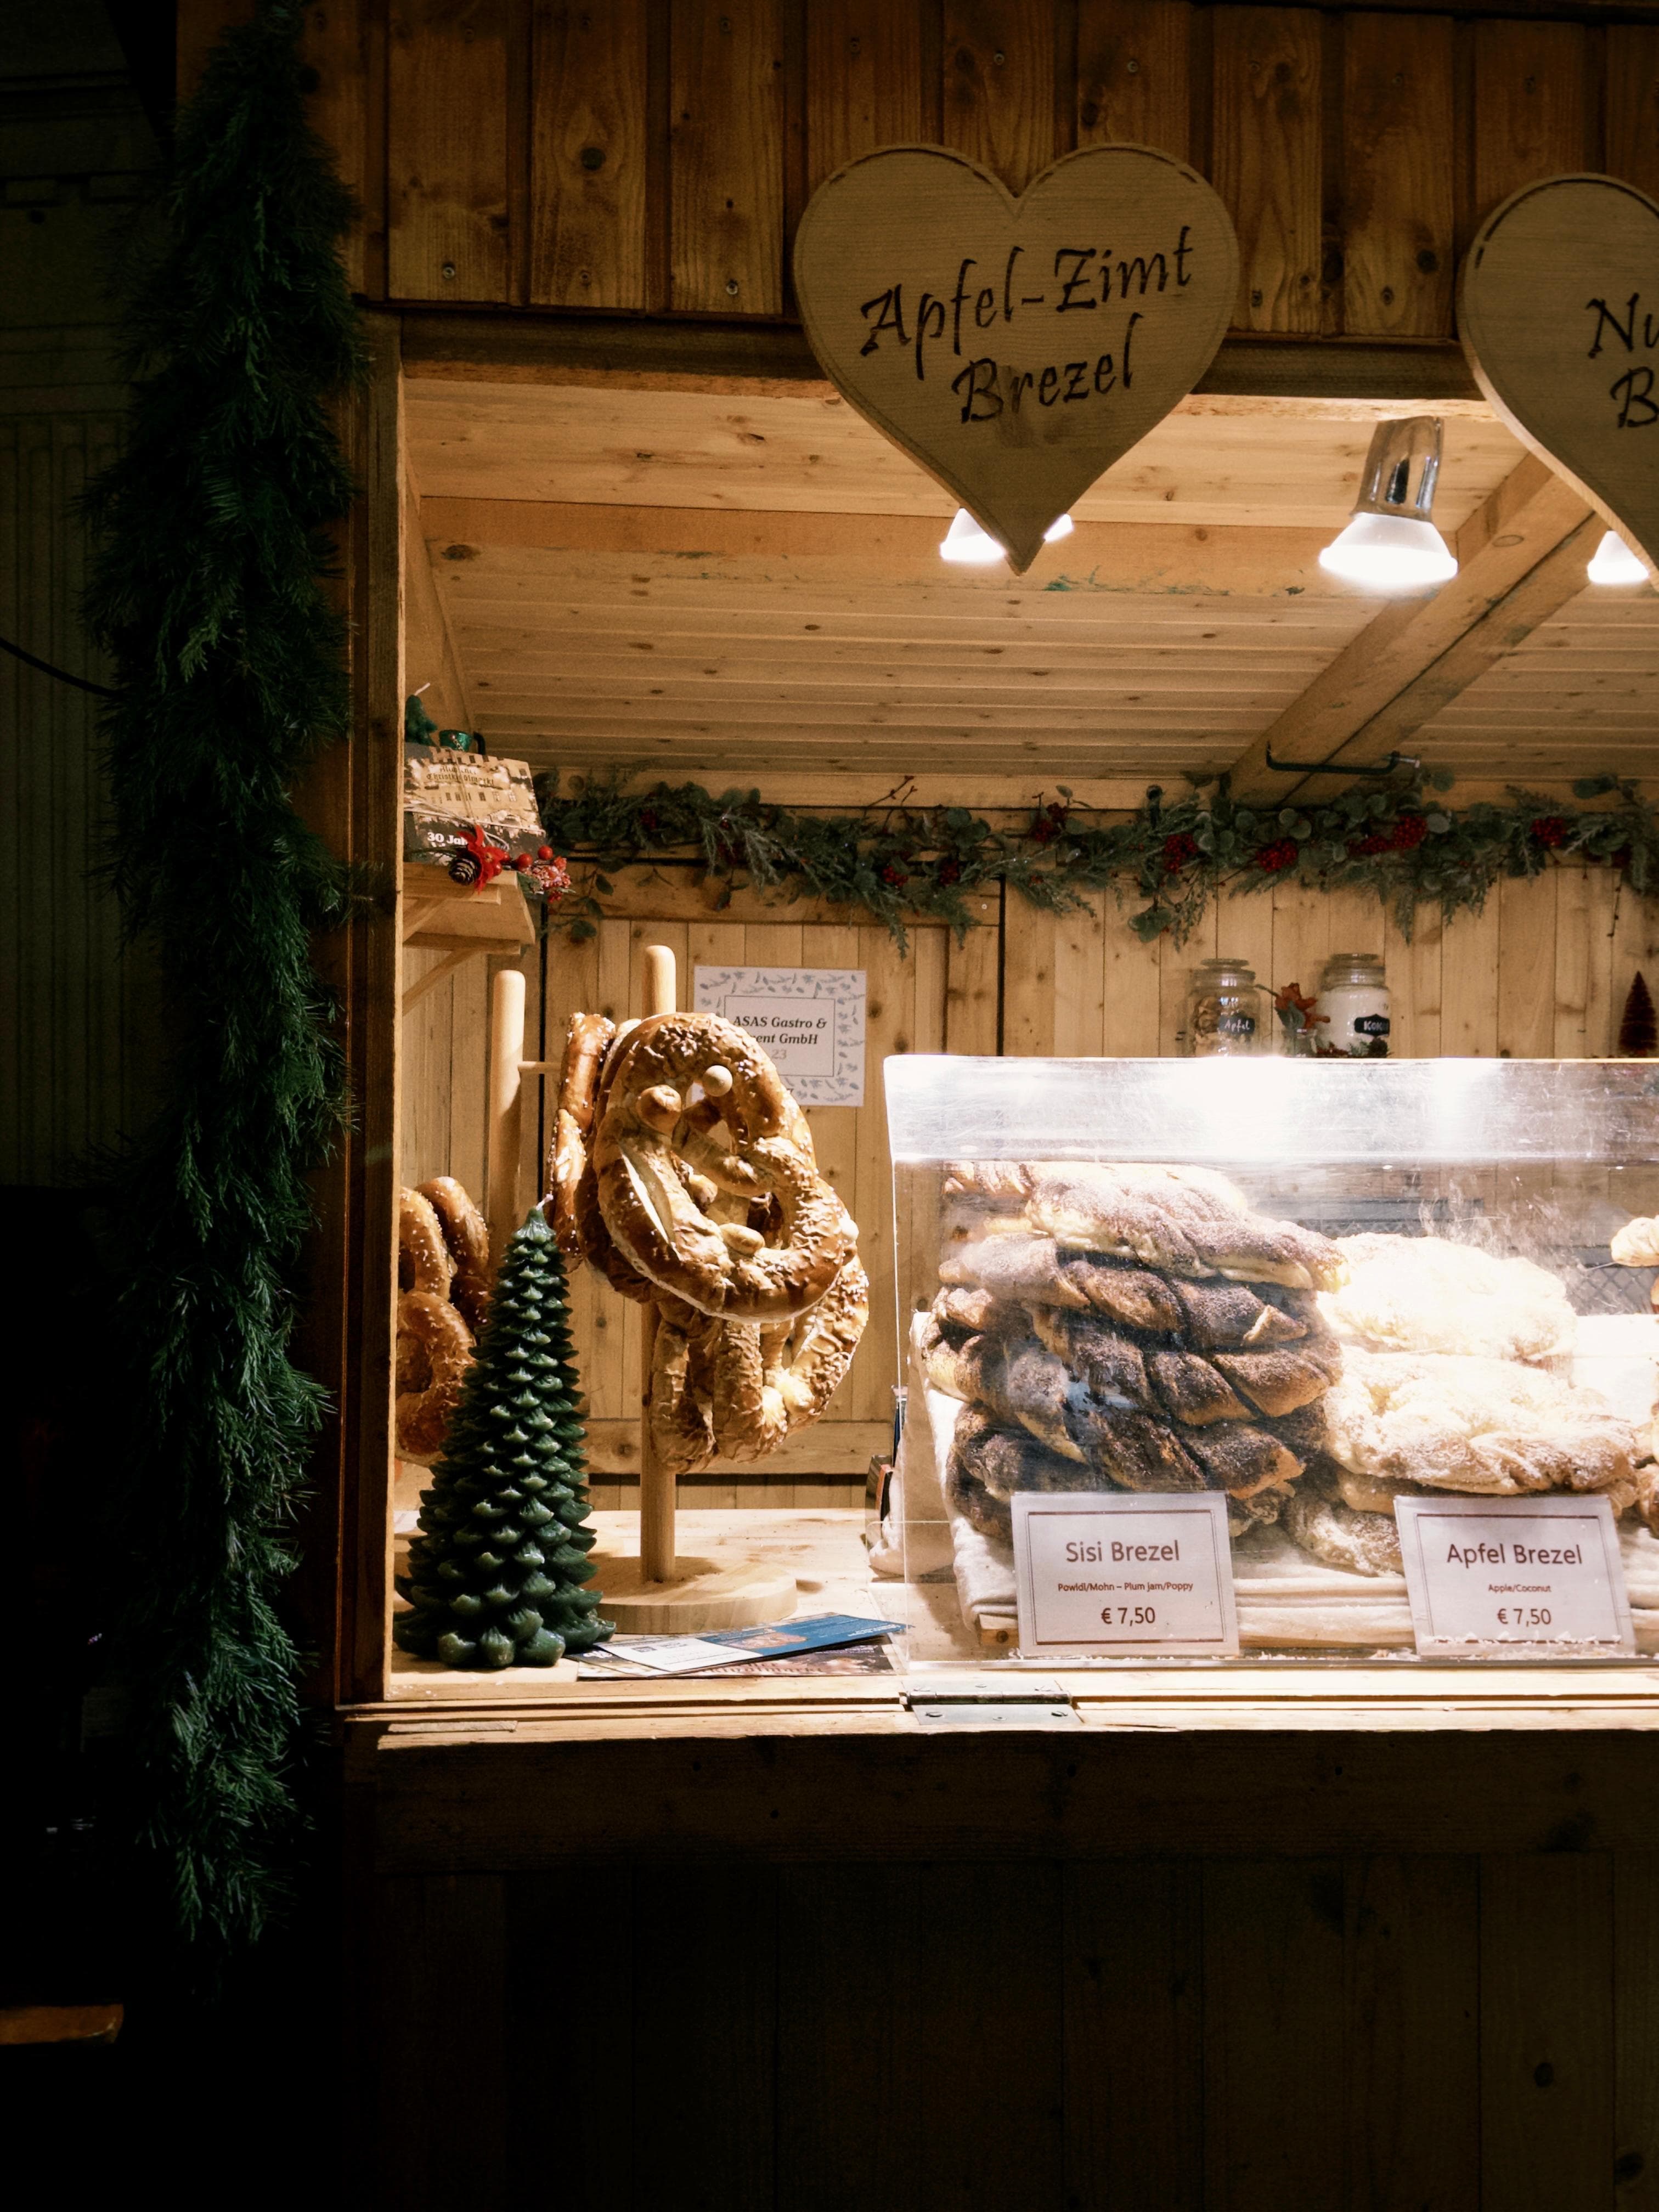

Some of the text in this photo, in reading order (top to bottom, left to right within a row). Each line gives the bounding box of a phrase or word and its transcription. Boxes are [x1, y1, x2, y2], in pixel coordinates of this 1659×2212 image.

[860, 225, 1193, 381] Apfel-Zimt
[1586, 292, 1659, 359] Nu
[951, 312, 1143, 424] Brezel
[427, 832, 445, 843] 30
[446, 834, 469, 846] Jah
[733, 1016, 827, 1029] ASAS Gastro &
[754, 1033, 818, 1045] ent GmbH
[1066, 1539, 1180, 1562] Sisi Brezel
[1447, 1543, 1582, 1568] Apfel Brezel
[1124, 1582, 1146, 1590] Plum
[1147, 1582, 1193, 1593] jam/Poppy
[1488, 1584, 1551, 1593] Apple/Coconut
[1101, 1607, 1155, 1627] € 7,50
[1497, 1608, 1551, 1627] € 7,50
